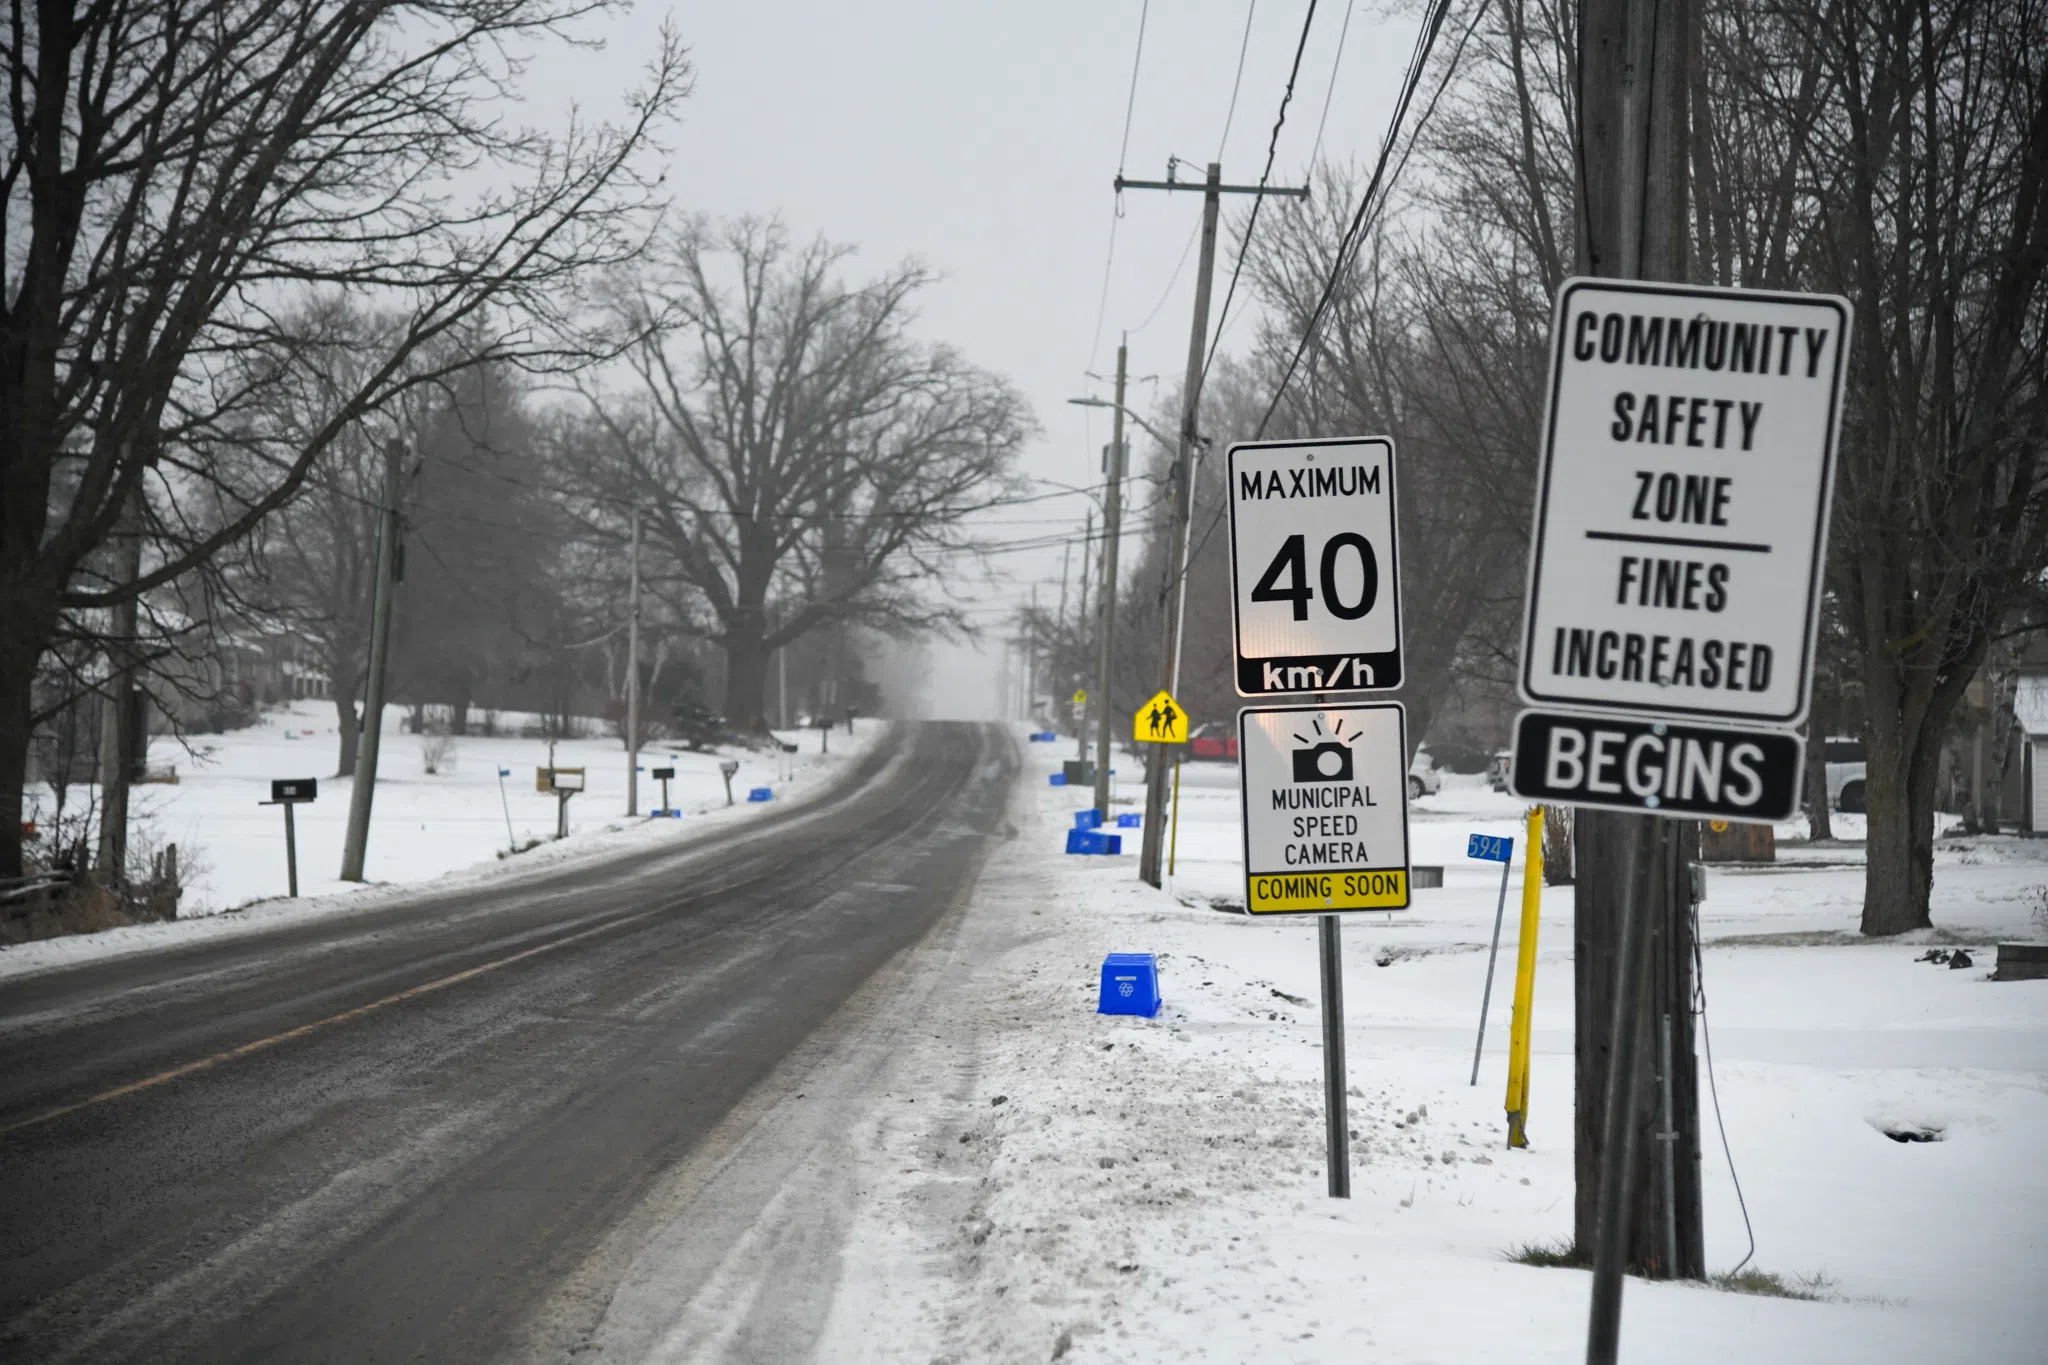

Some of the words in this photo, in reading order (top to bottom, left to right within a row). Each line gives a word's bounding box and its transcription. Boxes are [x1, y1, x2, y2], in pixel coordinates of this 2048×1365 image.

[1573, 311, 1829, 378] COMMUNITY
[1611, 391, 1763, 451] SAFETY
[1241, 465, 1380, 500] MAXIMUM
[1631, 470, 1733, 526] ZONE
[1251, 532, 1378, 621] 40
[1616, 555, 1731, 613] FINES
[1263, 658, 1375, 690] km/h
[1552, 627, 1774, 693] INCREASED
[1545, 727, 1766, 806] BEGINS
[1271, 786, 1377, 810] MUNICIPAL
[1293, 816, 1358, 838] SPEED
[1469, 835, 1502, 859] 594
[1285, 842, 1369, 865] CAMERA
[1257, 876, 1332, 900] COMING
[1344, 874, 1399, 896] SOON
